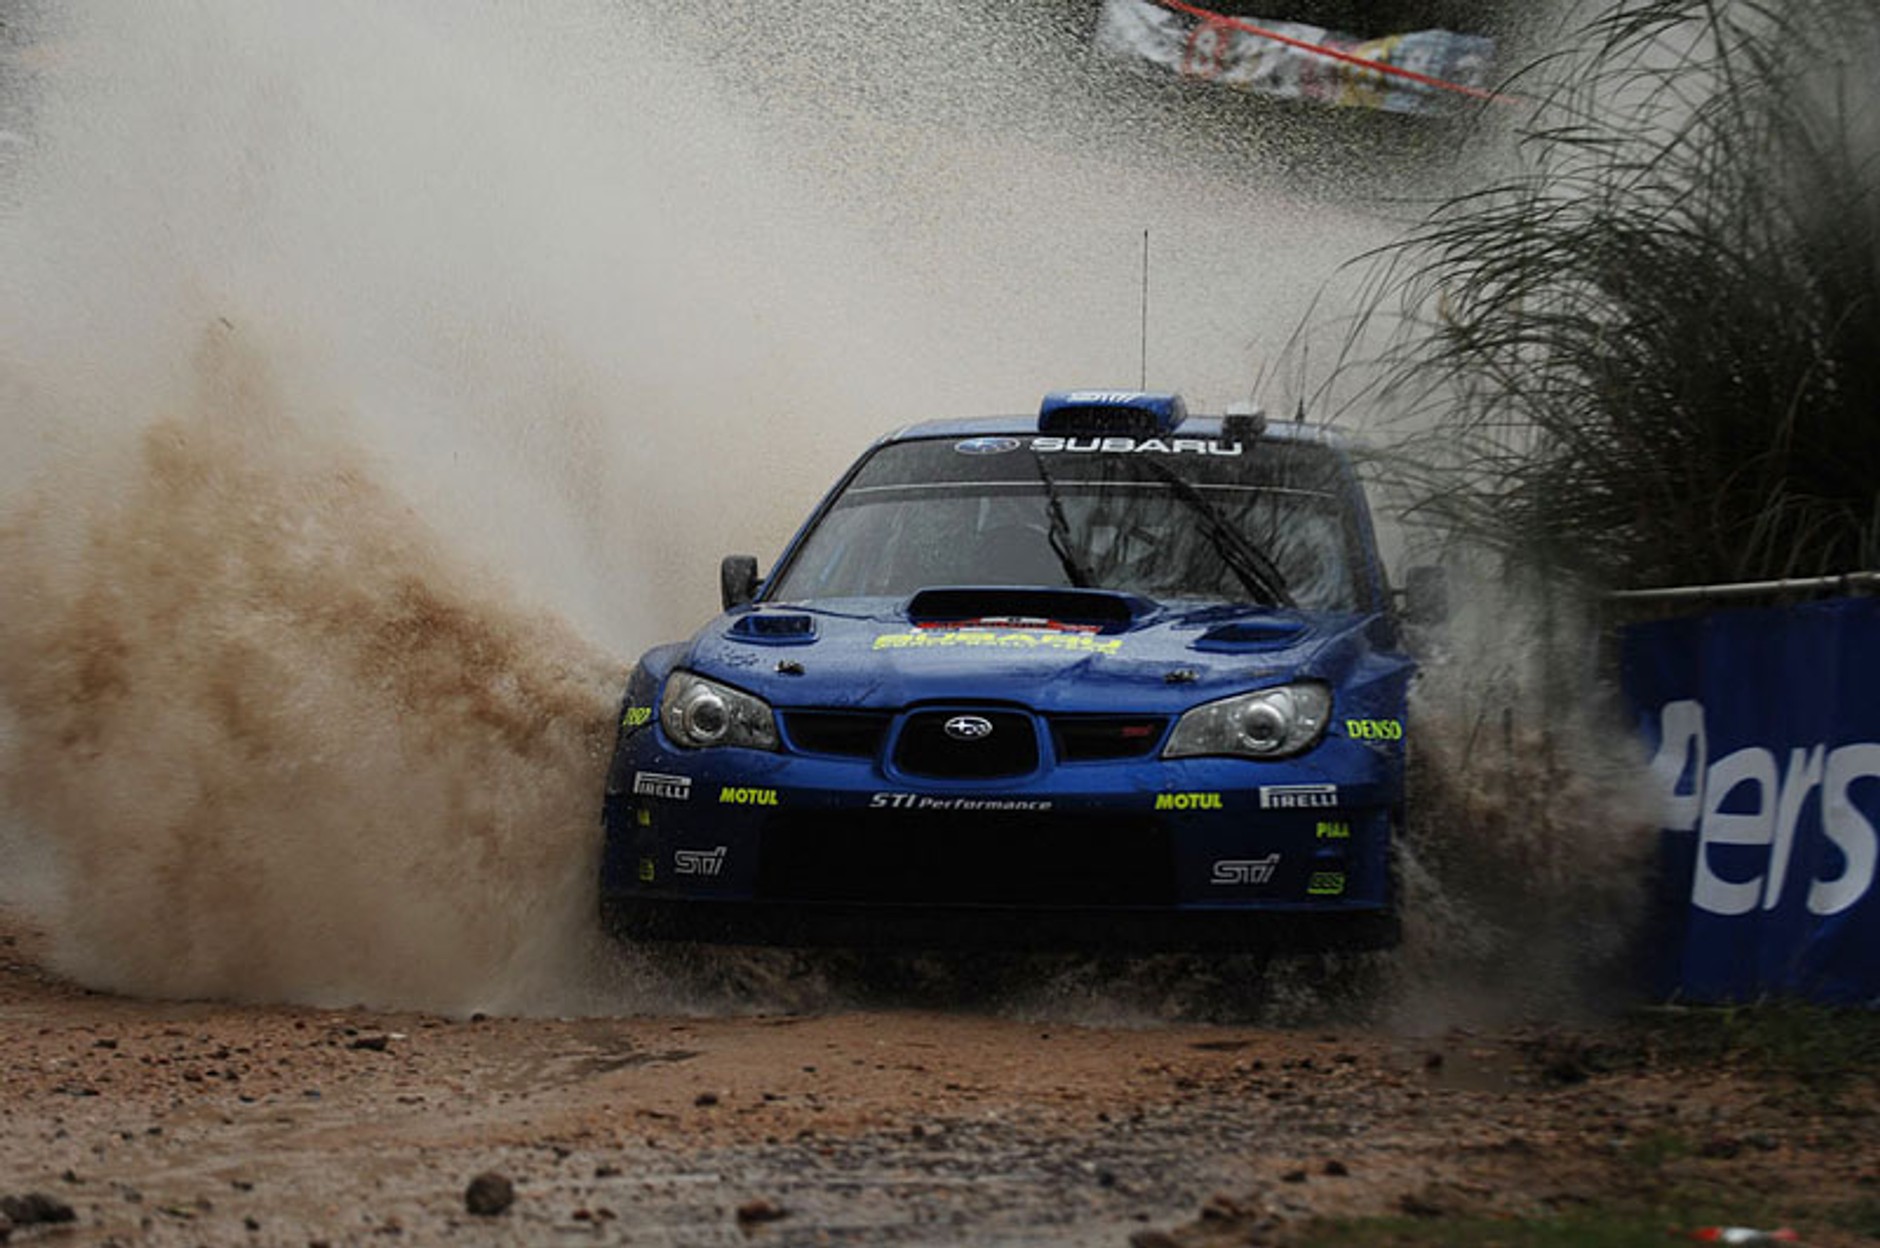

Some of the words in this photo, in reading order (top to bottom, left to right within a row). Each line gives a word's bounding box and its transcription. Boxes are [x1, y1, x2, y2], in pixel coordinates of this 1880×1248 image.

[1029, 437, 1242, 456] SUBARU
[1346, 719, 1403, 740] DENSO
[633, 770, 693, 799] PIRELLI
[719, 787, 778, 805] MOTUL
[869, 793, 916, 808] STI
[918, 797, 1052, 811] Performance
[1155, 793, 1223, 810] MOTUL
[1259, 784, 1338, 808] PIRELLI
